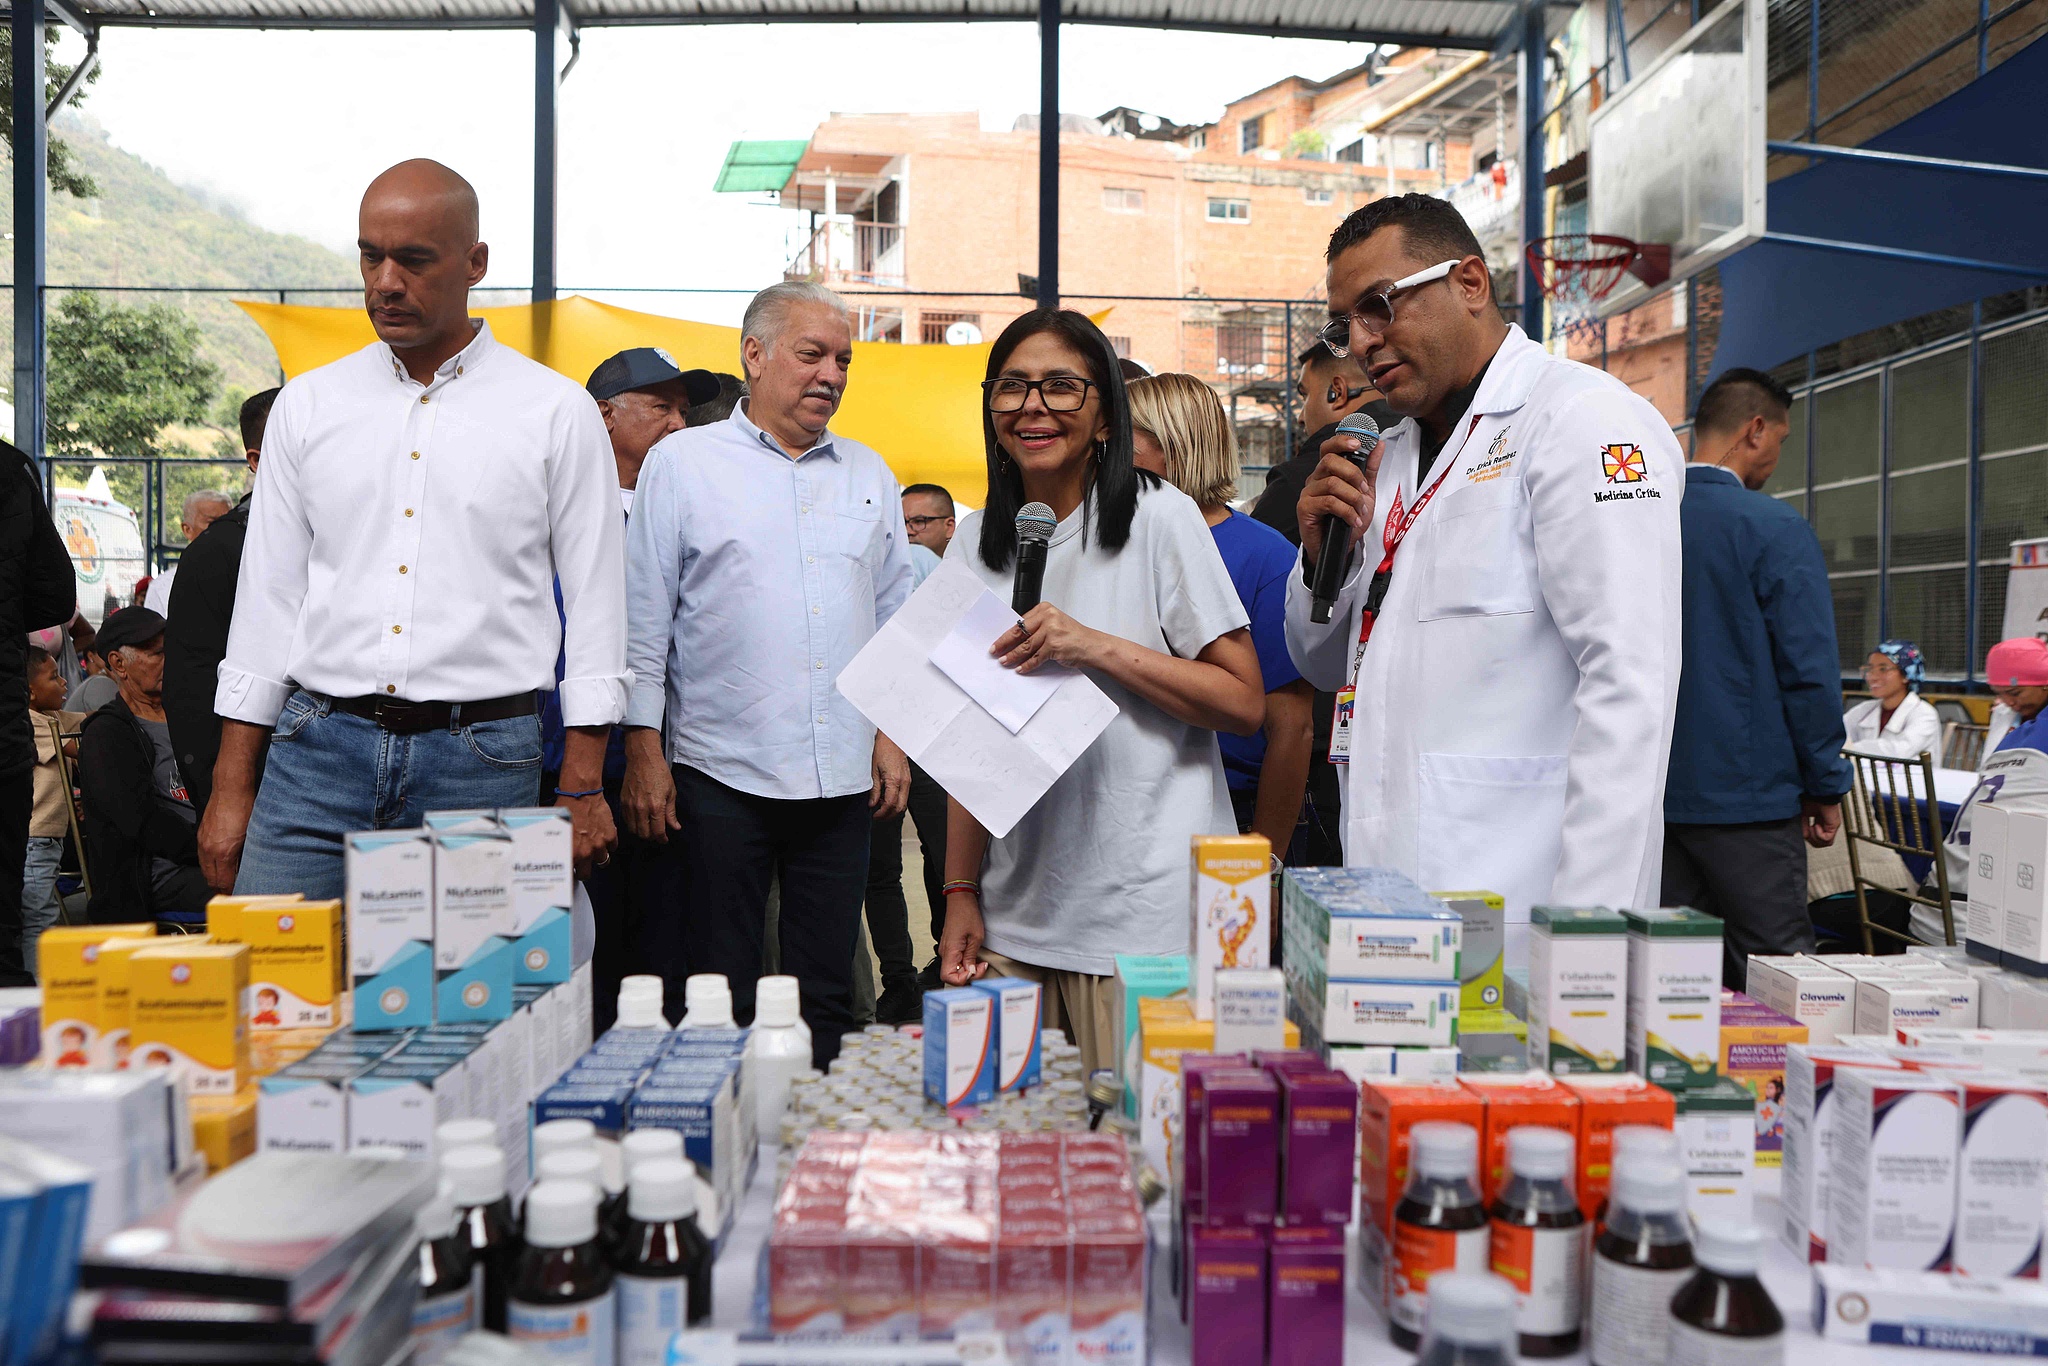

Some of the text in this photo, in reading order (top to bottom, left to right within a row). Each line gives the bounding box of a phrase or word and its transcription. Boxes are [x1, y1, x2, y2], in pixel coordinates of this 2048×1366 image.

[1593, 489, 1634, 502] Medicina
[360, 889, 423, 902] Nutamin
[446, 885, 506, 898] Nutamin
[1800, 993, 1846, 1002] Clavumix
[1892, 1008, 1940, 1017] Clavumix
